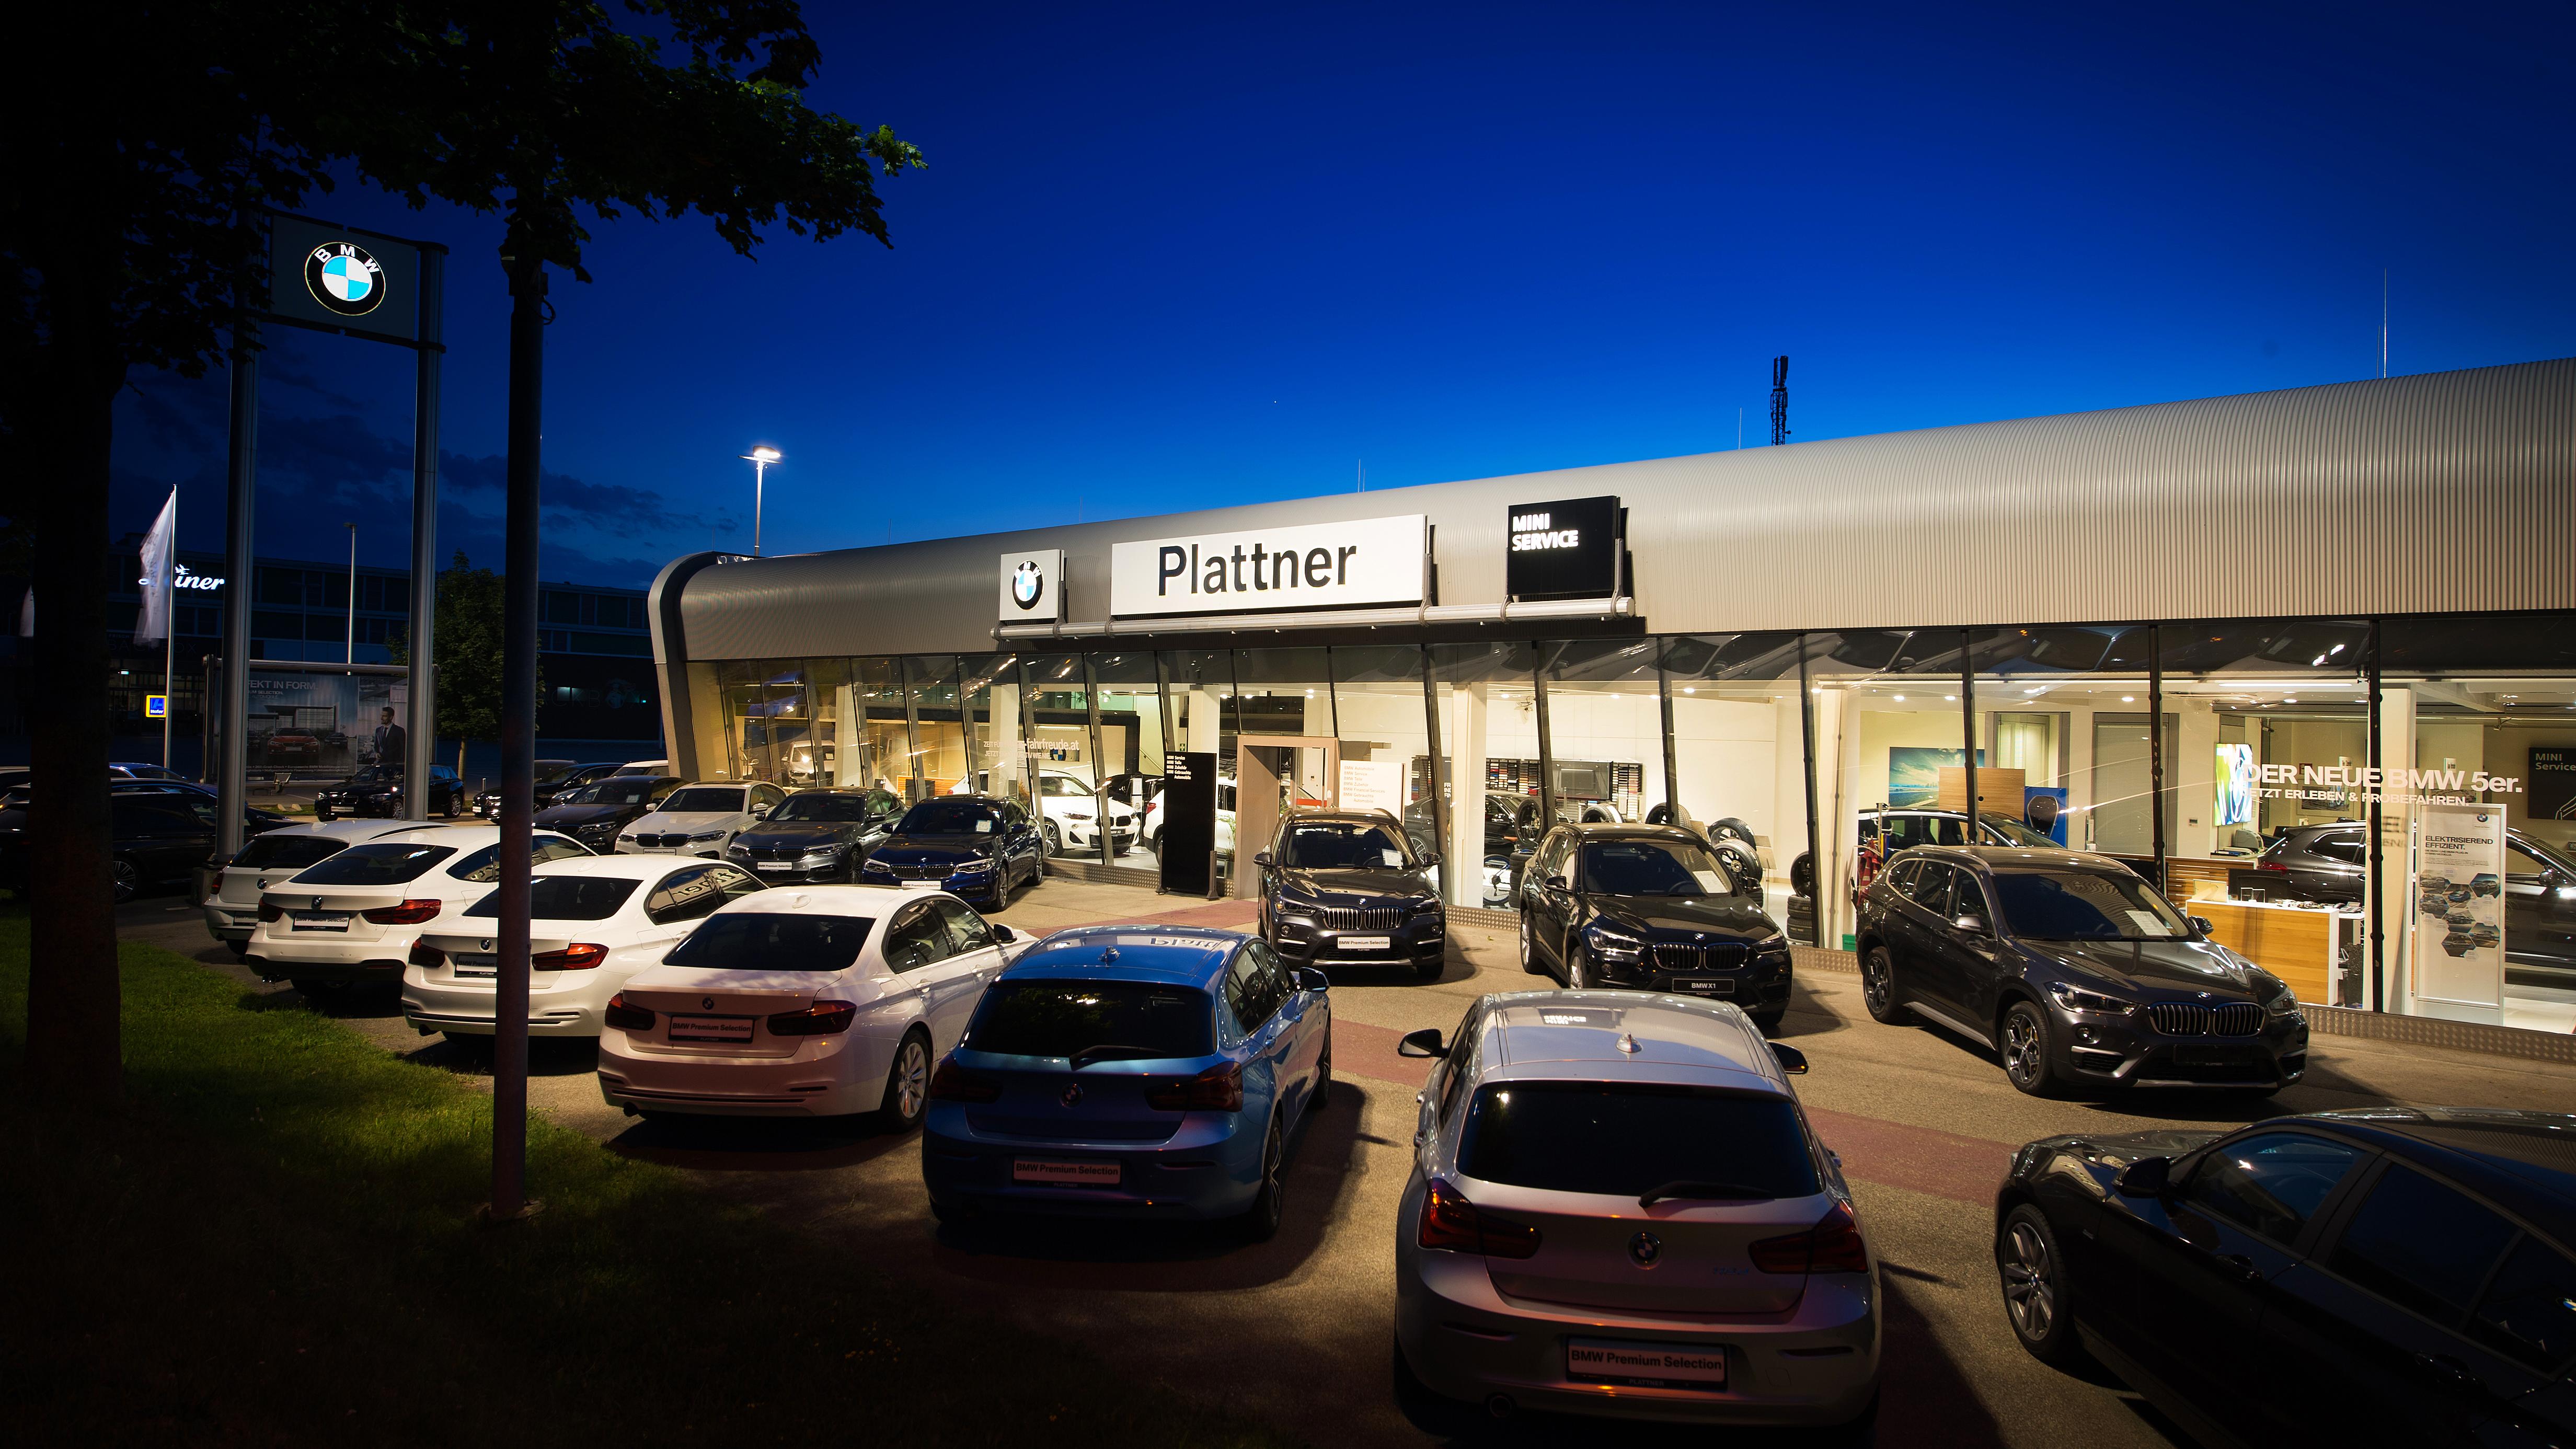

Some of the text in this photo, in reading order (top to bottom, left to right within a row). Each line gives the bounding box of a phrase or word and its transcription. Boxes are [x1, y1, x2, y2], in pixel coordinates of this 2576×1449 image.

[314, 244, 380, 273] BMW
[1512, 513, 1550, 532] MINI
[1512, 530, 1579, 551] SERVICE
[1014, 561, 1041, 579] BMW
[1158, 543, 1357, 596] Plattner
[273, 681, 284, 689] IN
[286, 681, 318, 691] FORM.
[2535, 753, 2562, 761] MINI
[2535, 762, 2576, 770] Service
[2242, 763, 2523, 793] DER NEUE BMW 5er.
[2284, 789, 2345, 802] ERLEBEN
[2348, 792, 2358, 802] &
[2362, 792, 2469, 807] PROBEFAHREN.
[2425, 835, 2493, 845] ELEKTRISIEREND
[1016, 1163, 1119, 1175] BMW Premium Selection
[1571, 1350, 1722, 1370] BMW Premium Selection
[1629, 1378, 1665, 1387] PLATTNER
